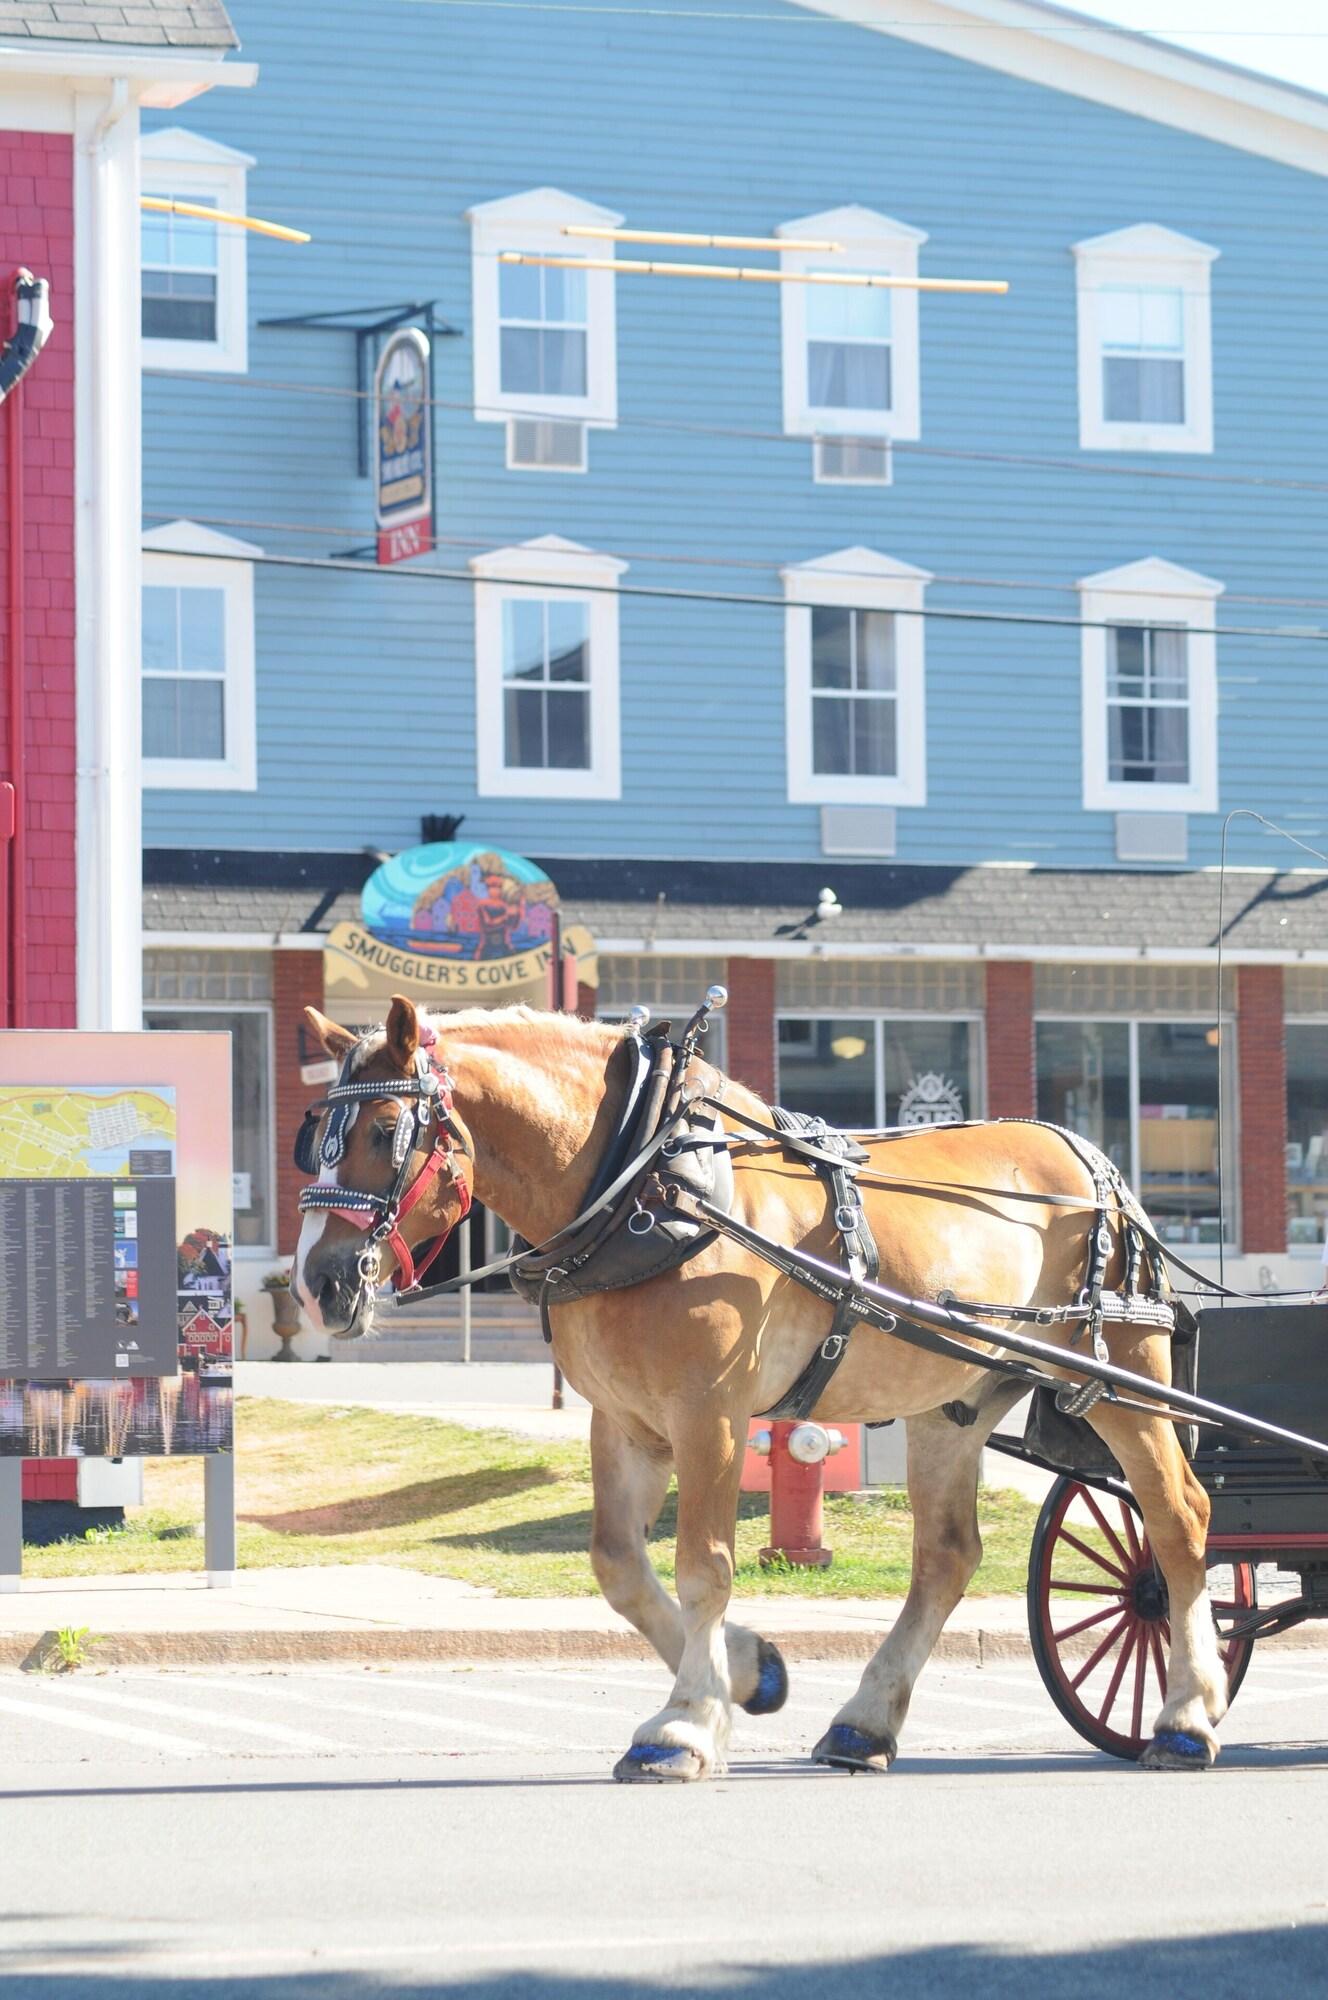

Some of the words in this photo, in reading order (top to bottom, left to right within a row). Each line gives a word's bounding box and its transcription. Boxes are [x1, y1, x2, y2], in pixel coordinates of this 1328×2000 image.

[391, 524, 421, 560] INN
[344, 932, 468, 985] SMUGGLER'S
[476, 961, 528, 985] COVE
